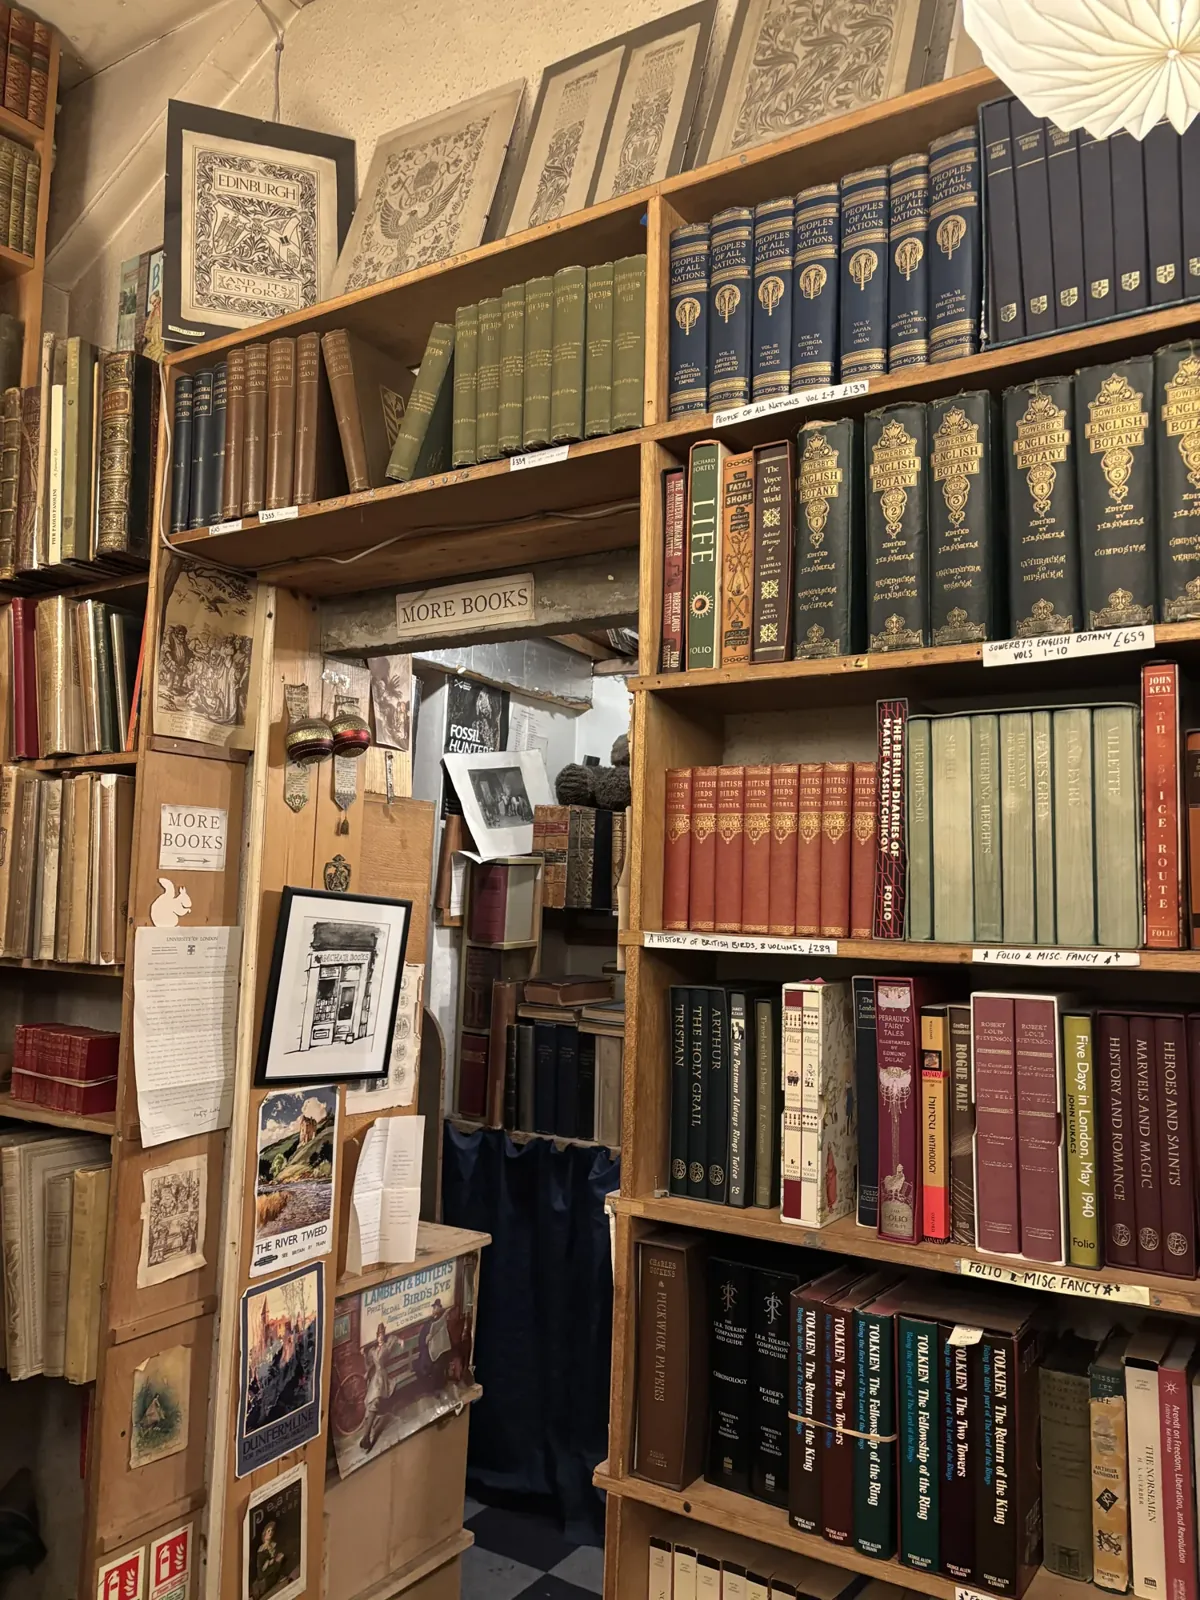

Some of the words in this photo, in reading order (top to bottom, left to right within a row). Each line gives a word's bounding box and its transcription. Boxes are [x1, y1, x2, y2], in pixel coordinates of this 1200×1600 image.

[218, 174, 296, 200] EDINBURGH
[931, 164, 973, 186] PEOPLES
[935, 181, 947, 191] OF
[948, 175, 967, 187] ALL
[931, 182, 972, 203] NATIONS
[796, 218, 834, 234] PEOPLES
[799, 231, 811, 240] OF
[812, 227, 828, 237] ALL
[796, 235, 833, 250] NATIONS
[226, 275, 256, 286] AND
[267, 282, 288, 292] ITS
[233, 283, 279, 297] STORY
[715, 412, 739, 424] PEOPLE
[742, 408, 753, 417] OF
[754, 404, 766, 413] ALL
[768, 398, 799, 410] NATIONS
[842, 383, 867, 396] £139
[1094, 403, 1139, 418] SOWERBY'S
[1090, 416, 1143, 434] ENGLISH
[1094, 433, 1142, 450] BOTANY
[693, 458, 716, 466] RICHARD
[1114, 469, 1122, 479] 5
[728, 482, 752, 491] FATAL
[763, 475, 782, 483] Voyce
[770, 484, 781, 492] the
[726, 493, 752, 504] SHORE
[762, 494, 782, 504] World
[691, 498, 715, 564] LIFE
[402, 600, 456, 624] MORE
[461, 588, 528, 615] BOOKS
[988, 639, 1033, 652] SOWERBY'S
[1036, 636, 1071, 648] ENGLISH
[1076, 632, 1113, 643] BOTANY
[1113, 630, 1145, 648] £659
[1013, 650, 1033, 660] VOLS
[1044, 646, 1068, 657] 1-10
[1149, 675, 1172, 686] JOHN
[1149, 685, 1172, 694] KEAY
[450, 723, 481, 743] FOSSIL
[882, 718, 891, 757] MARIE
[892, 717, 902, 742] THE
[892, 743, 902, 790] BERLIN
[1107, 726, 1120, 796] VILLETTE
[914, 759, 925, 823] PROFESSOR
[1037, 780, 1049, 820] GREY
[880, 761, 890, 854] VASSILTCHIKOV
[891, 791, 901, 843] DIARIES
[168, 812, 220, 829] MORE
[162, 832, 223, 850] BOOKS
[890, 845, 900, 858] OF
[1157, 844, 1169, 909] ROUTE
[883, 885, 892, 921] FOLIO
[648, 934, 654, 943] A
[657, 936, 687, 945] HISTORY
[689, 937, 698, 945] OF
[701, 938, 729, 948] BRITISH
[731, 941, 757, 950] BIRDS,
[768, 943, 805, 953] VOLUMES,
[808, 944, 831, 954] £289
[1151, 929, 1177, 937] FOLIO
[996, 951, 1021, 960] FOLIO
[1065, 953, 1099, 963] FANCY
[692, 1006, 702, 1036] THE
[879, 1014, 910, 1023] PERRAULT'S
[884, 1022, 904, 1030] FAIRY
[675, 1004, 684, 1067] TRISTAN
[711, 1007, 721, 1070] ARTHUR
[1075, 1035, 1089, 1059] Five
[692, 1041, 702, 1079] HOLY
[733, 1042, 741, 1057] The
[955, 1043, 968, 1080] ROGUE
[732, 1058, 741, 1094] Postman
[1074, 1061, 1089, 1092] Days
[1109, 1037, 1121, 1096] HISTORY
[1136, 1039, 1150, 1101] MARVELS
[1163, 1041, 1177, 1096] HEROES
[691, 1082, 702, 1127] GRAIL
[955, 1081, 968, 1111] MALE
[1067, 1094, 1076, 1119] JOHN
[1077, 1095, 1087, 1106] in
[732, 1095, 741, 1127] Always
[1111, 1100, 1123, 1129] AND
[1138, 1105, 1150, 1137] AND
[1165, 1100, 1179, 1131] AND
[732, 1129, 740, 1154] Rings
[1069, 1120, 1077, 1154] LUKACS
[1078, 1110, 1091, 1160] London,
[731, 1155, 740, 1179] Twice
[1112, 1132, 1126, 1201] ROMANCE
[1140, 1141, 1153, 1189] MAGIC
[1167, 1134, 1182, 1187] SAINTS
[1079, 1162, 1093, 1187] May
[1082, 1192, 1095, 1218] 1940
[255, 1241, 272, 1255] THE
[275, 1234, 298, 1249] RIVER
[301, 1225, 328, 1242] TWEED
[1072, 1237, 1095, 1250] Folio
[968, 1261, 1002, 1278] FOLIO
[1023, 1272, 1056, 1289] MISC.
[1060, 1277, 1101, 1295] FANCY
[364, 1277, 408, 1307] LAMBERT
[407, 1278, 414, 1289] &
[403, 1287, 432, 1308] BIRD'S
[433, 1279, 451, 1296] EYE
[656, 1291, 668, 1353] PICKWICK
[916, 1334, 929, 1384] TOLKIEN
[654, 1355, 666, 1402] PAPERS
[713, 1371, 748, 1385] CHRONOLOGY
[993, 1348, 1006, 1399] TOLKIEN
[759, 1386, 785, 1399] READER'S
[762, 1396, 781, 1406] GUIDE
[917, 1389, 929, 1408] The
[994, 1404, 1007, 1424] The
[1172, 1404, 1181, 1428] Arendt
[242, 1409, 315, 1456] DUNFERMLINE
[916, 1409, 930, 1463] Fellowship
[994, 1426, 1008, 1462] Return
[1174, 1429, 1181, 1438] on
[1173, 1439, 1182, 1475] Freedom,
[918, 1466, 930, 1479] of
[995, 1465, 1007, 1479] of
[917, 1481, 931, 1500] the
[995, 1480, 1008, 1500] the
[1146, 1465, 1157, 1523] NORSEMEN
[1174, 1475, 1184, 1511] Liberation,
[916, 1501, 931, 1521] Ring
[993, 1501, 1009, 1525] King
[1177, 1511, 1185, 1526] and
[1178, 1527, 1187, 1564] Revolution
